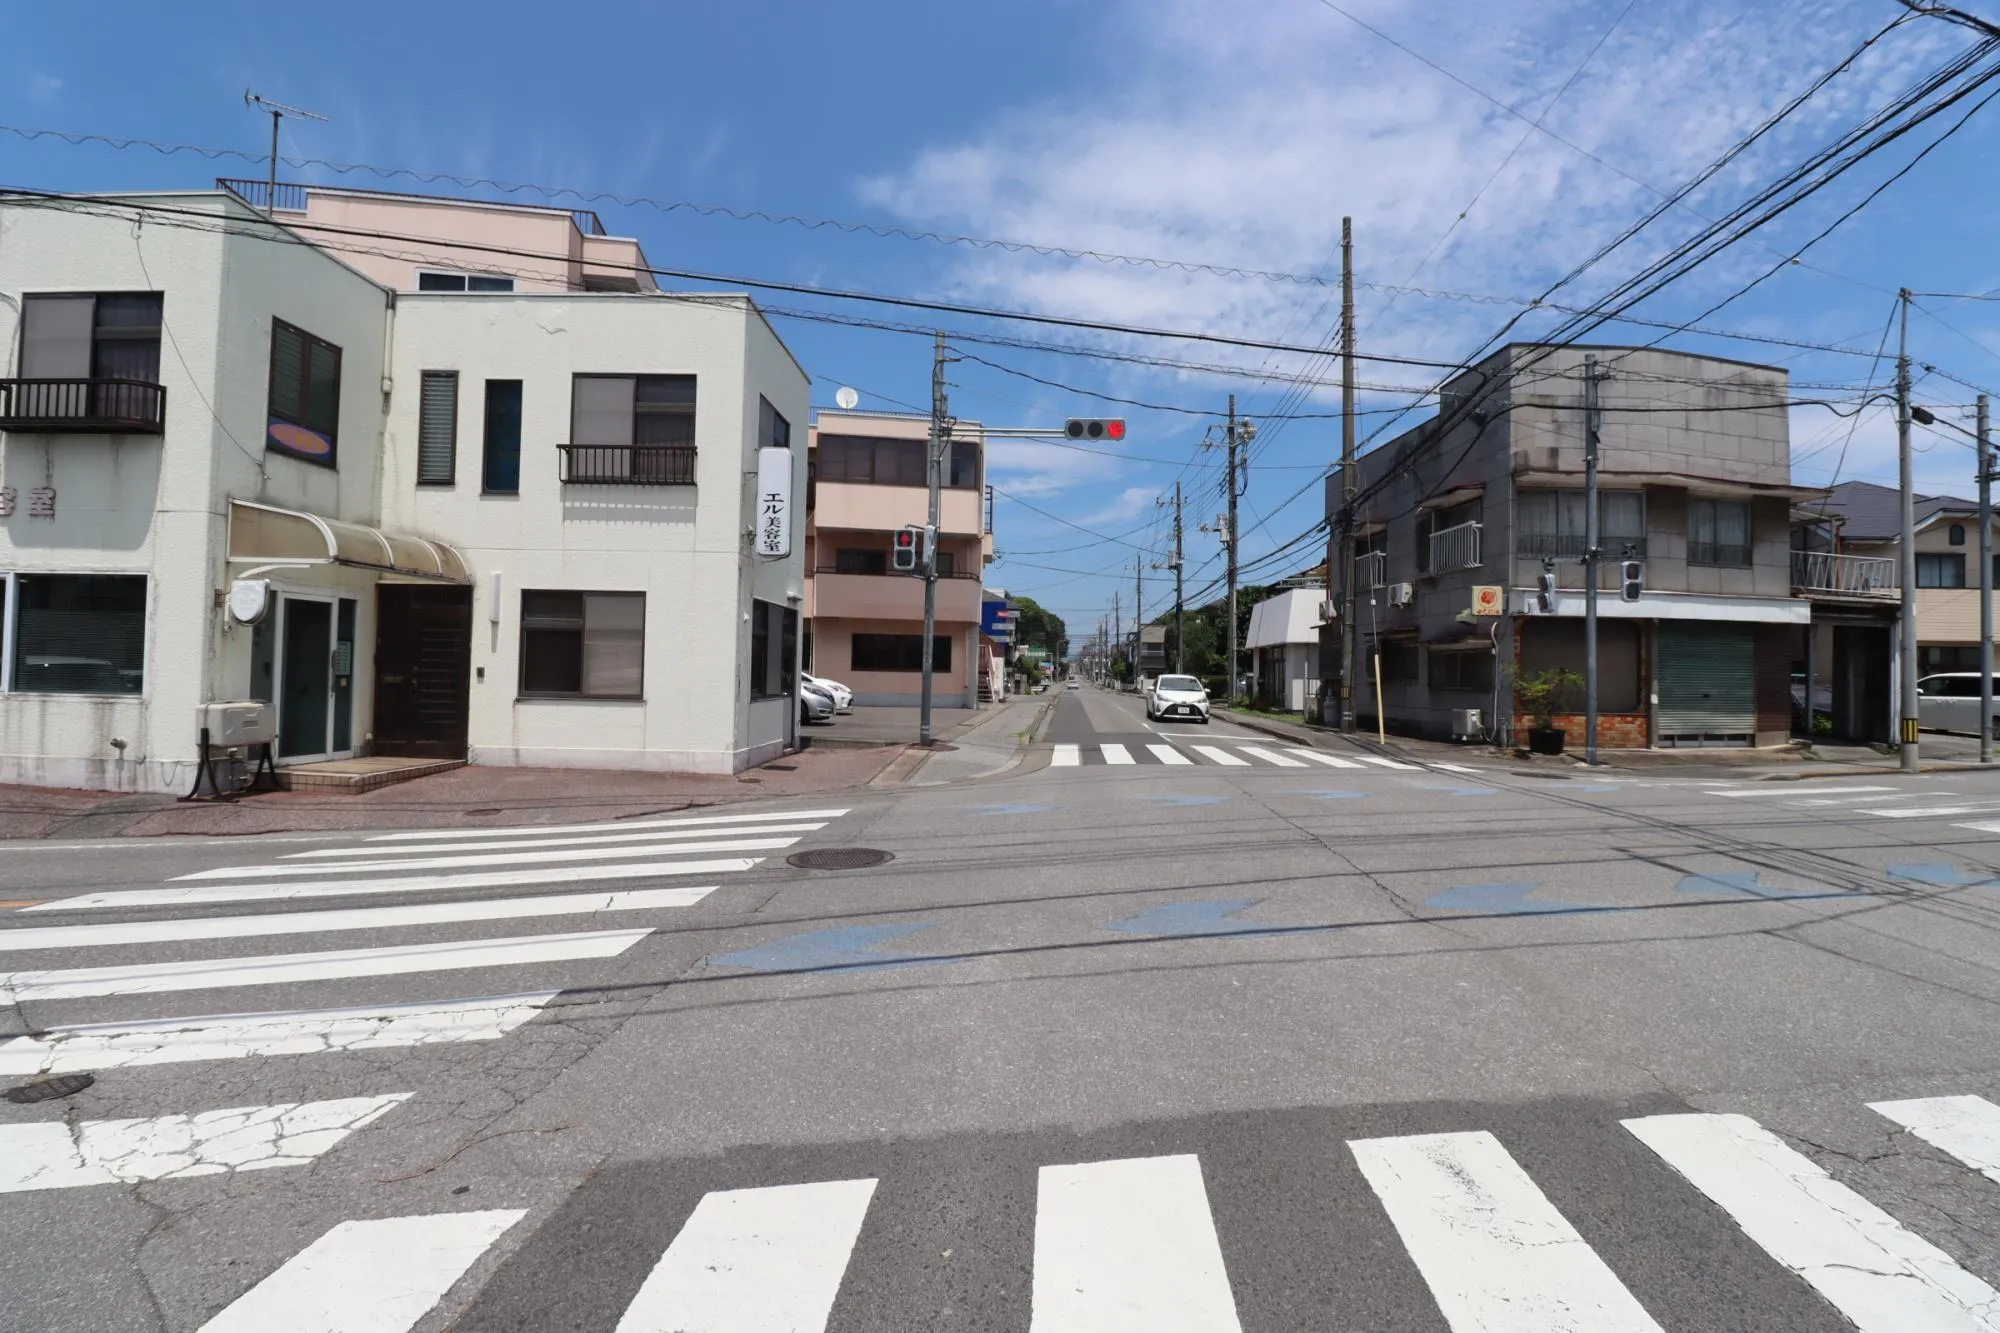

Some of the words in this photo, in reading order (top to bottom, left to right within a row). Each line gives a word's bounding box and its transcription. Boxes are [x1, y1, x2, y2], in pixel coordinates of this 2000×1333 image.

[763, 493, 784, 552] エル美容室
